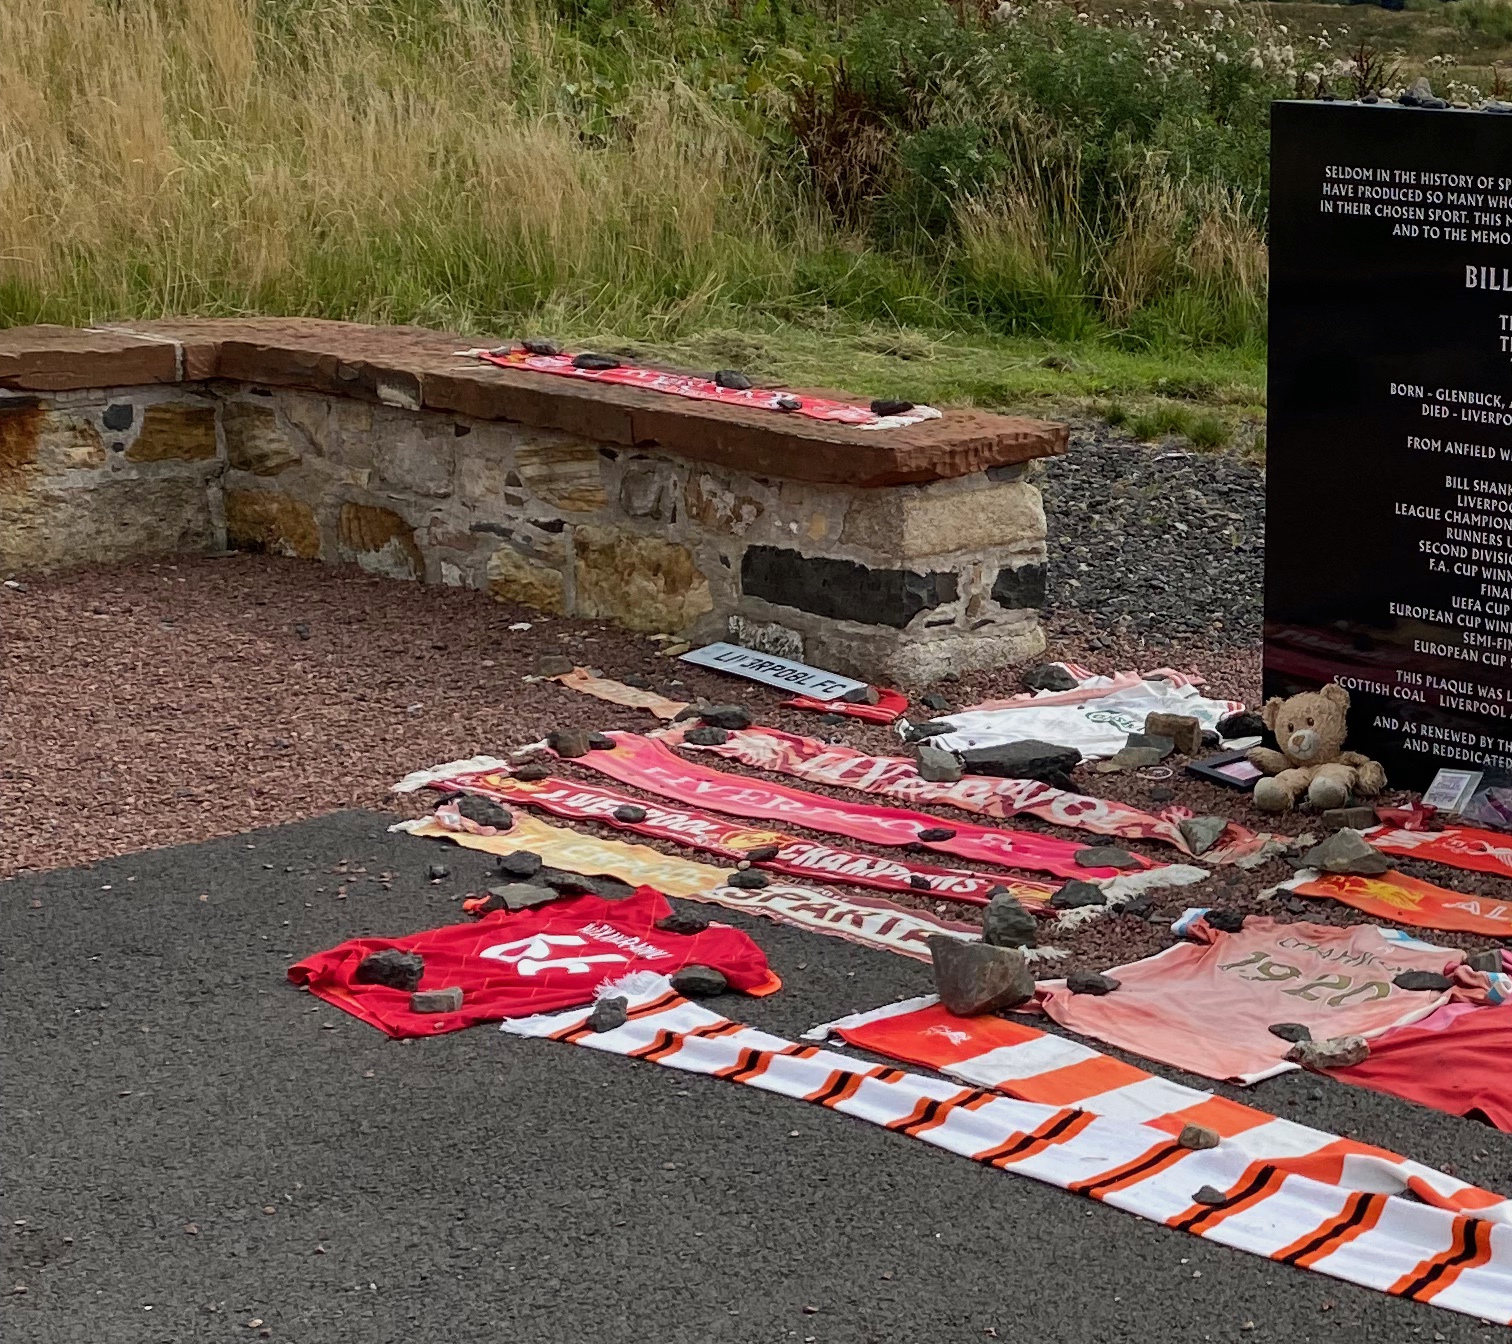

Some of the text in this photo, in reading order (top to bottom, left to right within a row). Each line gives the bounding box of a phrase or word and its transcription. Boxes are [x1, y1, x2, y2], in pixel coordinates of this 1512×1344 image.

[1324, 164, 1373, 181] SELDOM
[1392, 169, 1417, 184] THE
[1420, 171, 1474, 188] HISTORY
[1476, 175, 1494, 189] OF
[1322, 181, 1354, 197] HAVE
[1357, 184, 1423, 202] PRODUCED
[1446, 191, 1484, 207] MANY
[1319, 198, 1333, 213] IN
[1335, 200, 1371, 216] THEIR
[1373, 203, 1424, 220] CHOSEN
[1427, 207, 1470, 224] SPORT.
[1472, 211, 1502, 226] THIS
[1391, 222, 1419, 237] AND
[1421, 224, 1440, 239] TO
[1442, 226, 1467, 242] THE
[1389, 381, 1424, 398] BORN
[1434, 387, 1506, 410] GLENBUCK,
[1420, 402, 1449, 418] DIED
[1406, 435, 1442, 452] FROM
[1443, 440, 1496, 459] ANFIELD
[1444, 474, 1470, 490] BILL
[1394, 501, 1441, 521] LEAGUE
[1418, 538, 1468, 558] SECOND
[1445, 526, 1503, 547] RUNNERS
[1452, 561, 1479, 577] CUP
[1388, 601, 1453, 624] EUROPEAN
[1456, 613, 1481, 628] CUP
[1451, 594, 1482, 612] UEFA
[1484, 600, 1510, 616] CUP
[1413, 639, 1478, 662] EUROPEAN
[1481, 651, 1507, 667] CUP
[810, 679, 847, 694] FC
[1332, 674, 1390, 696] SCOTTISH
[1392, 685, 1426, 703] COAL
[1439, 693, 1507, 718] LIVERPOOL
[1395, 669, 1422, 685] THIS
[1425, 674, 1473, 695] PLAQUE
[1476, 683, 1503, 700] WAS
[1372, 714, 1399, 730] AND
[1419, 723, 1476, 745] RENEWED
[1478, 734, 1494, 749] BY
[1402, 737, 1429, 753] AND
